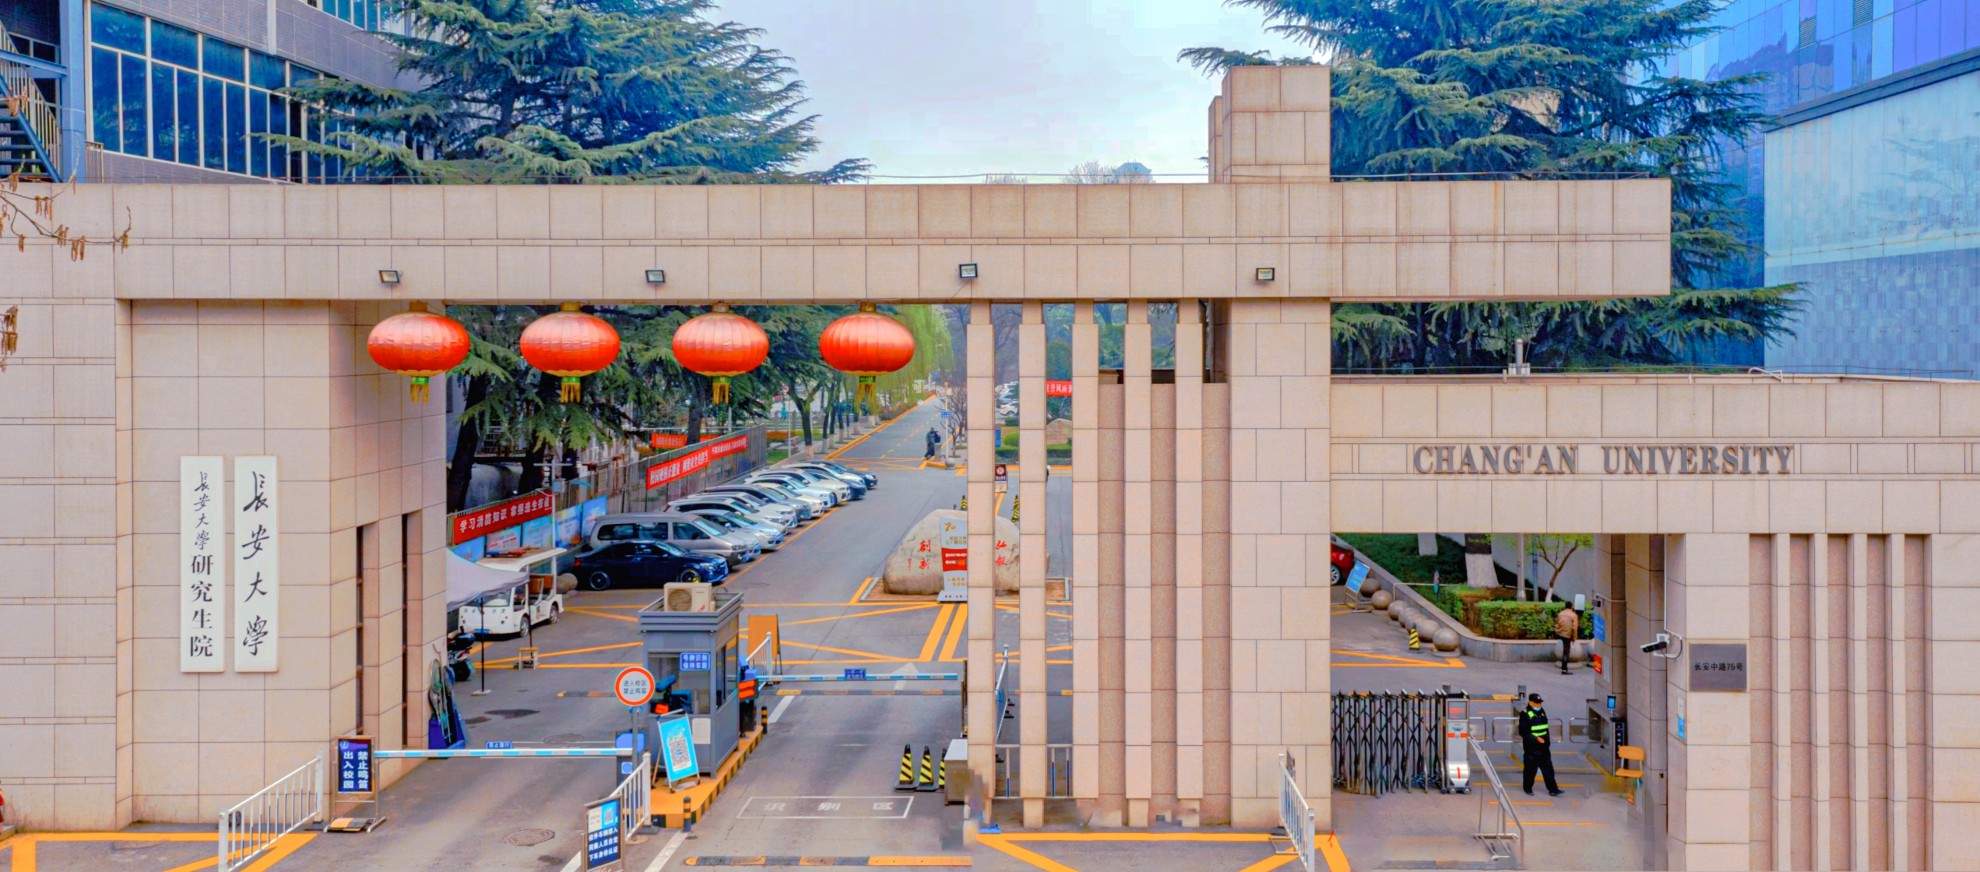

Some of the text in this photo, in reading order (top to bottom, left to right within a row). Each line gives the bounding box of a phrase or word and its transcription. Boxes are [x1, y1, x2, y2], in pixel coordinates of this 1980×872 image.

[1413, 445, 1794, 475] CHANG'AN UNIVERSITY
[460, 508, 507, 533] 学习消防知识
[1694, 662, 1744, 671] 长安中路75号
[623, 687, 648, 695] 禁止鸣笛
[343, 751, 354, 789] 出入校园
[357, 751, 368, 789] 禁止鸣笛
